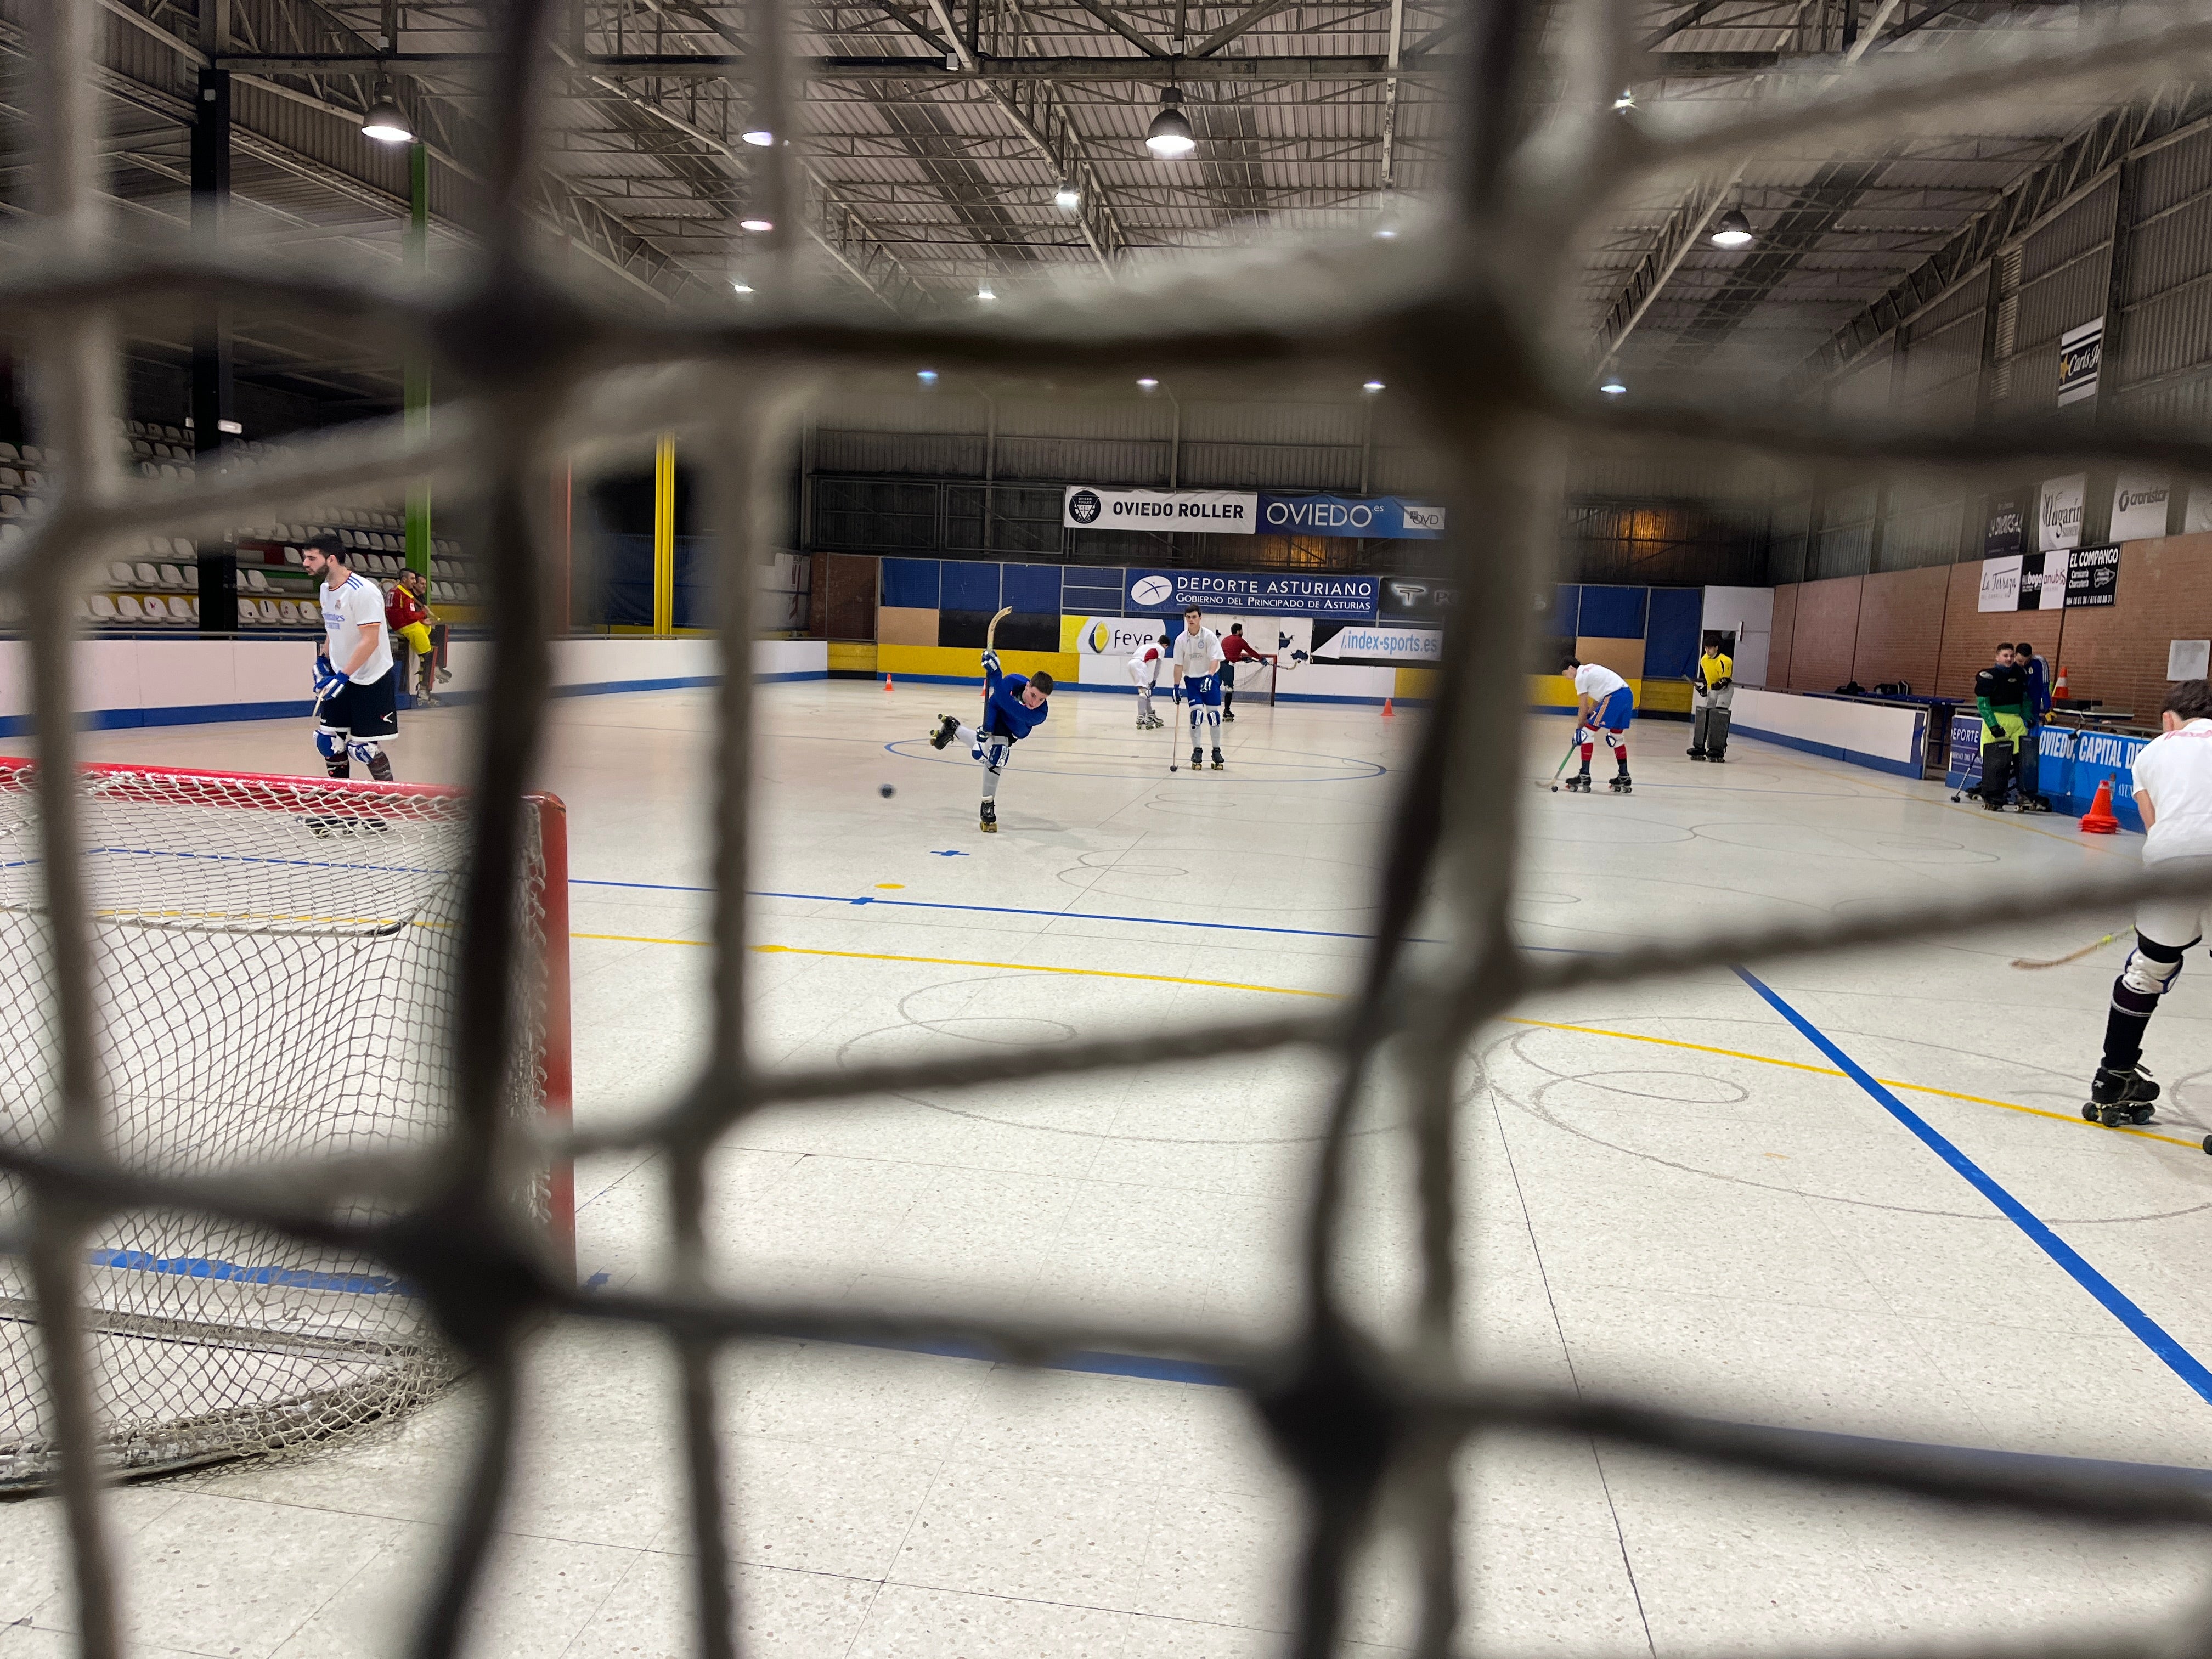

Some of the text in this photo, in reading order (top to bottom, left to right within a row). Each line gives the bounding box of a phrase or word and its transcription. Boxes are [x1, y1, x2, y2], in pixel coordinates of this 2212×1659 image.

[1113, 501, 1244, 518] OVIEDO ROLLER
[2069, 548, 2118, 568] EL COMPANGO
[1177, 577, 1372, 596] DEPORTE ASTURIANO
[1227, 597, 1243, 606] DEL
[1114, 630, 1153, 648] feve
[2079, 736, 2122, 768] CAPITAL
